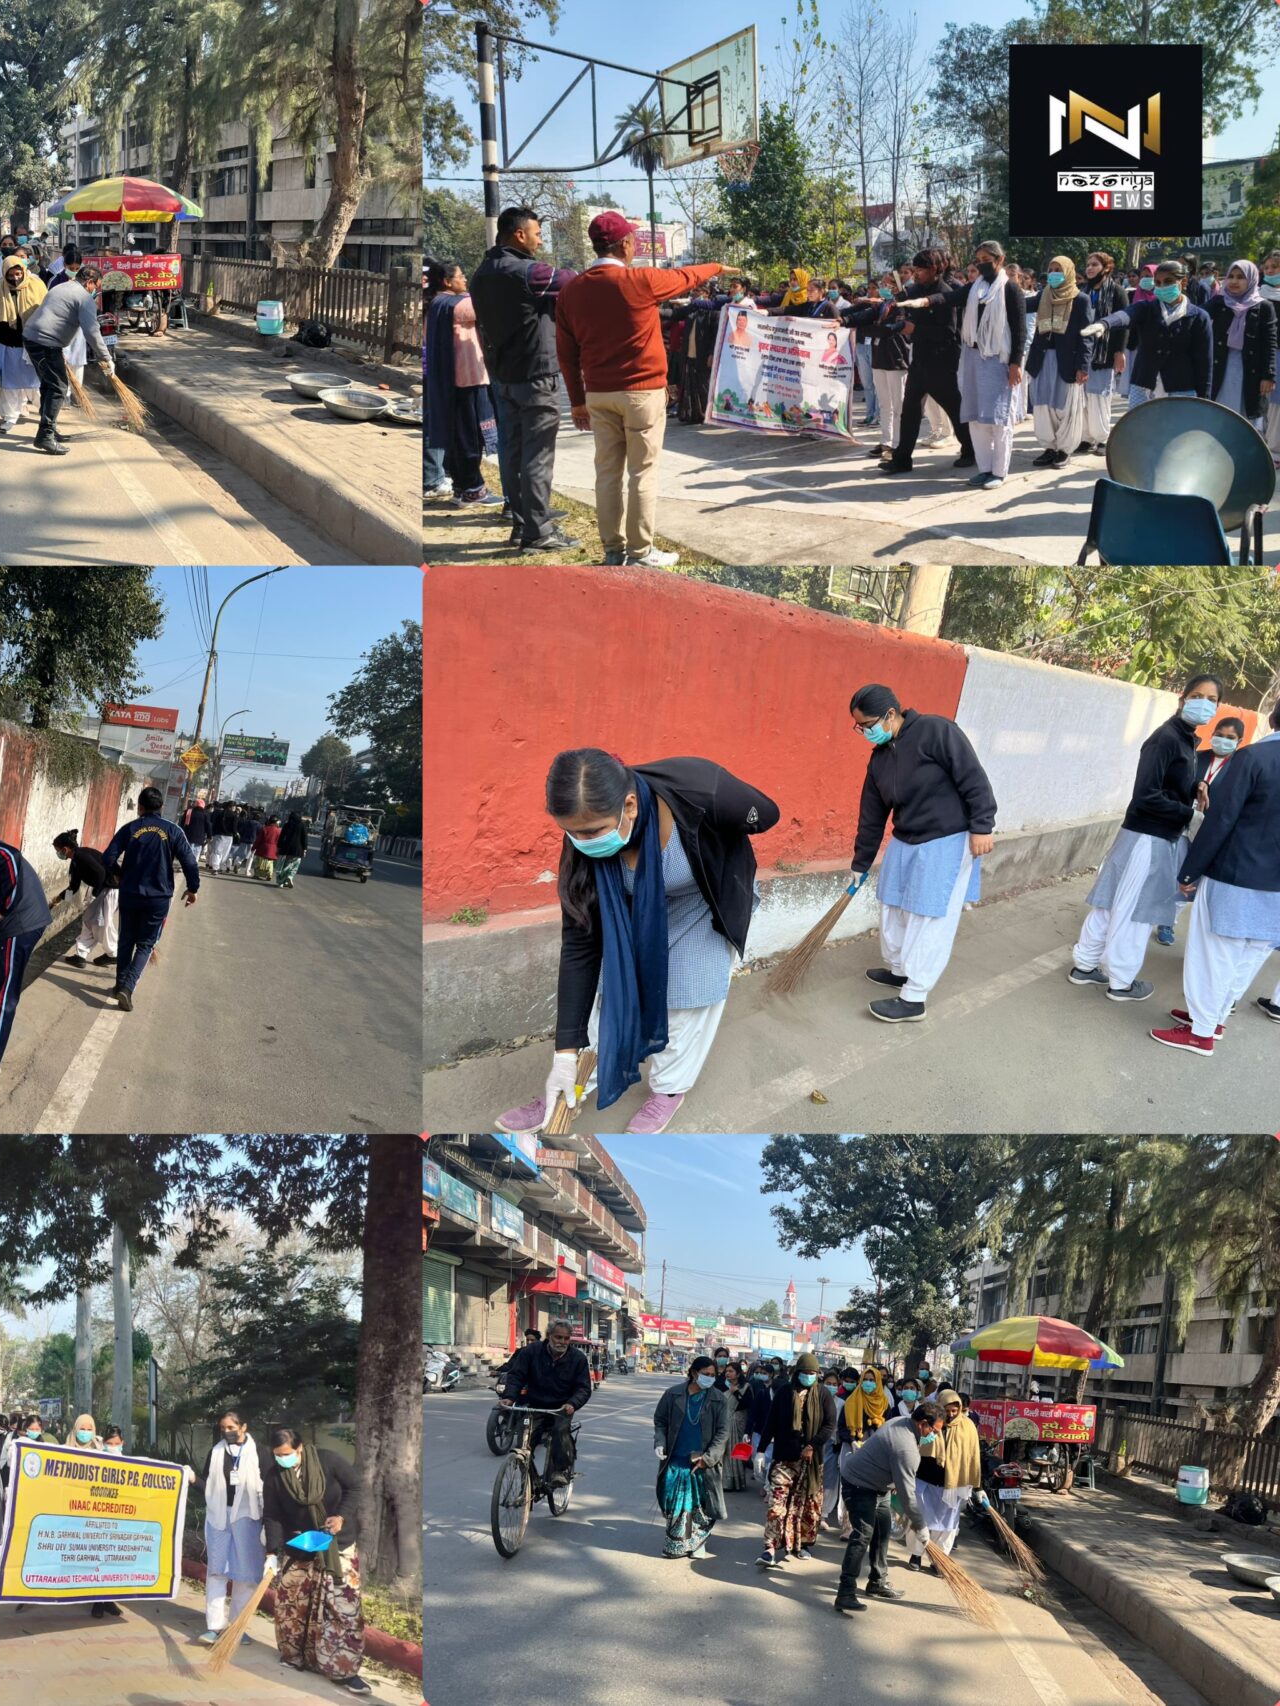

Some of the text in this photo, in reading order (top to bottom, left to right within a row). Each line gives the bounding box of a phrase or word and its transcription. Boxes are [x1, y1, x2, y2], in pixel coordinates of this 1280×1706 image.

[44, 1458, 176, 1490] METHODIST GIRLS P.G. COLLEGE
[69, 1499, 137, 1516] (NAAC ACCREDITED)
[37, 1530, 56, 1539] H.N.B.
[57, 1531, 81, 1540] GARHWAL
[37, 1542, 118, 1552] SHRI DEV SUMAN UNIVERSITY
[61, 1554, 76, 1562] TEHRI
[25, 1574, 70, 1584] UTTARAKHAND
[71, 1574, 100, 1583] TECHNICAL
[101, 1574, 130, 1582] UNIVERSITY
